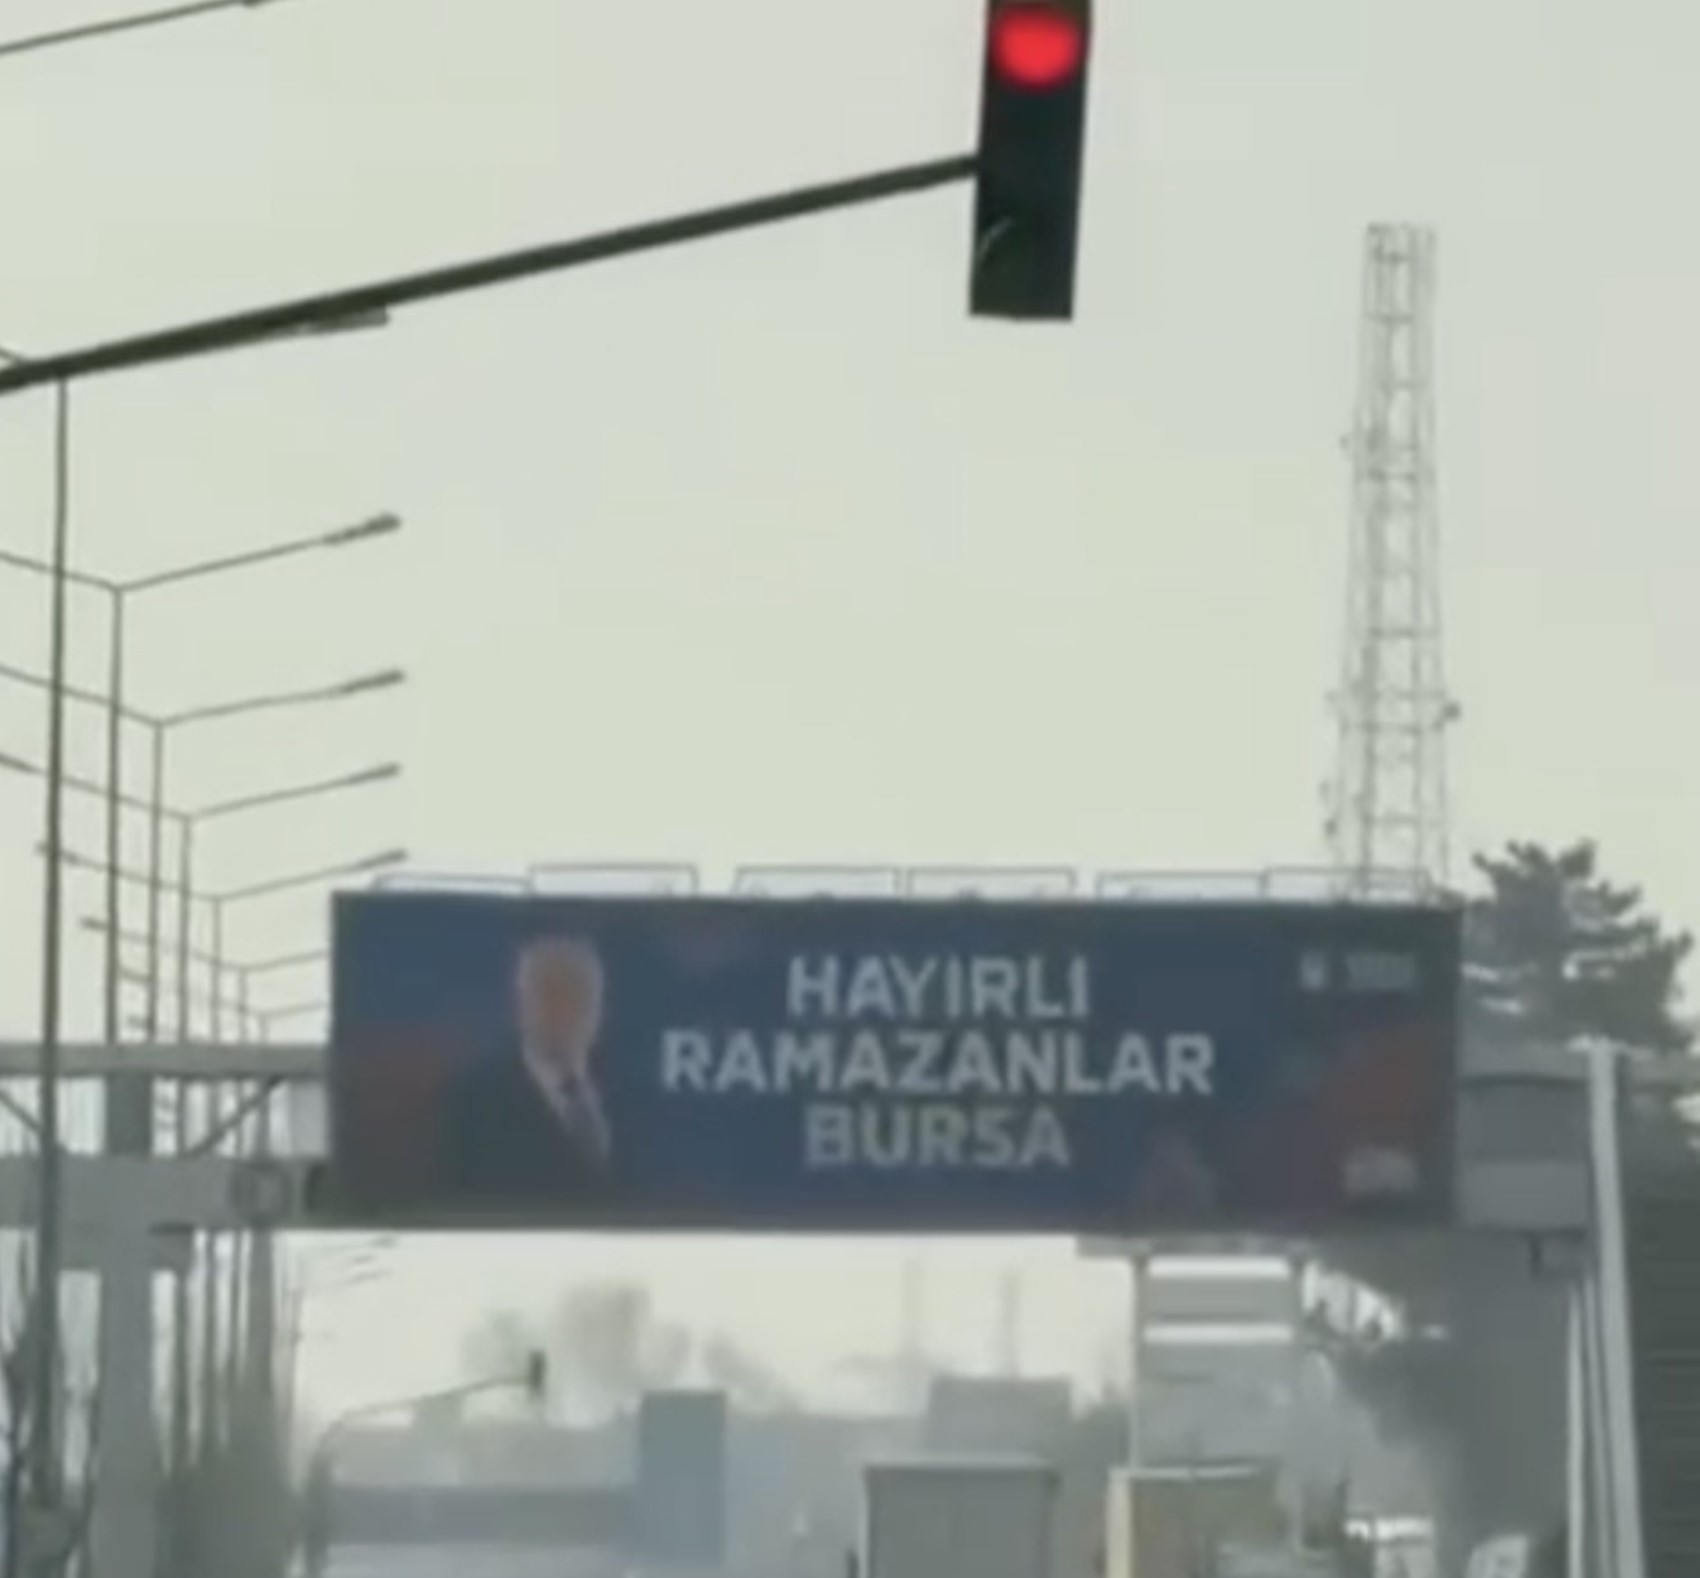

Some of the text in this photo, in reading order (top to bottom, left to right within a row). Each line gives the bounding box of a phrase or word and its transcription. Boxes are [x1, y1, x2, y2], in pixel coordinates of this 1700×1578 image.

[786, 953, 1089, 1019] HAYIRLI
[660, 1028, 1215, 1095] RAMAZANLAR
[804, 1101, 1071, 1168] BURSA
